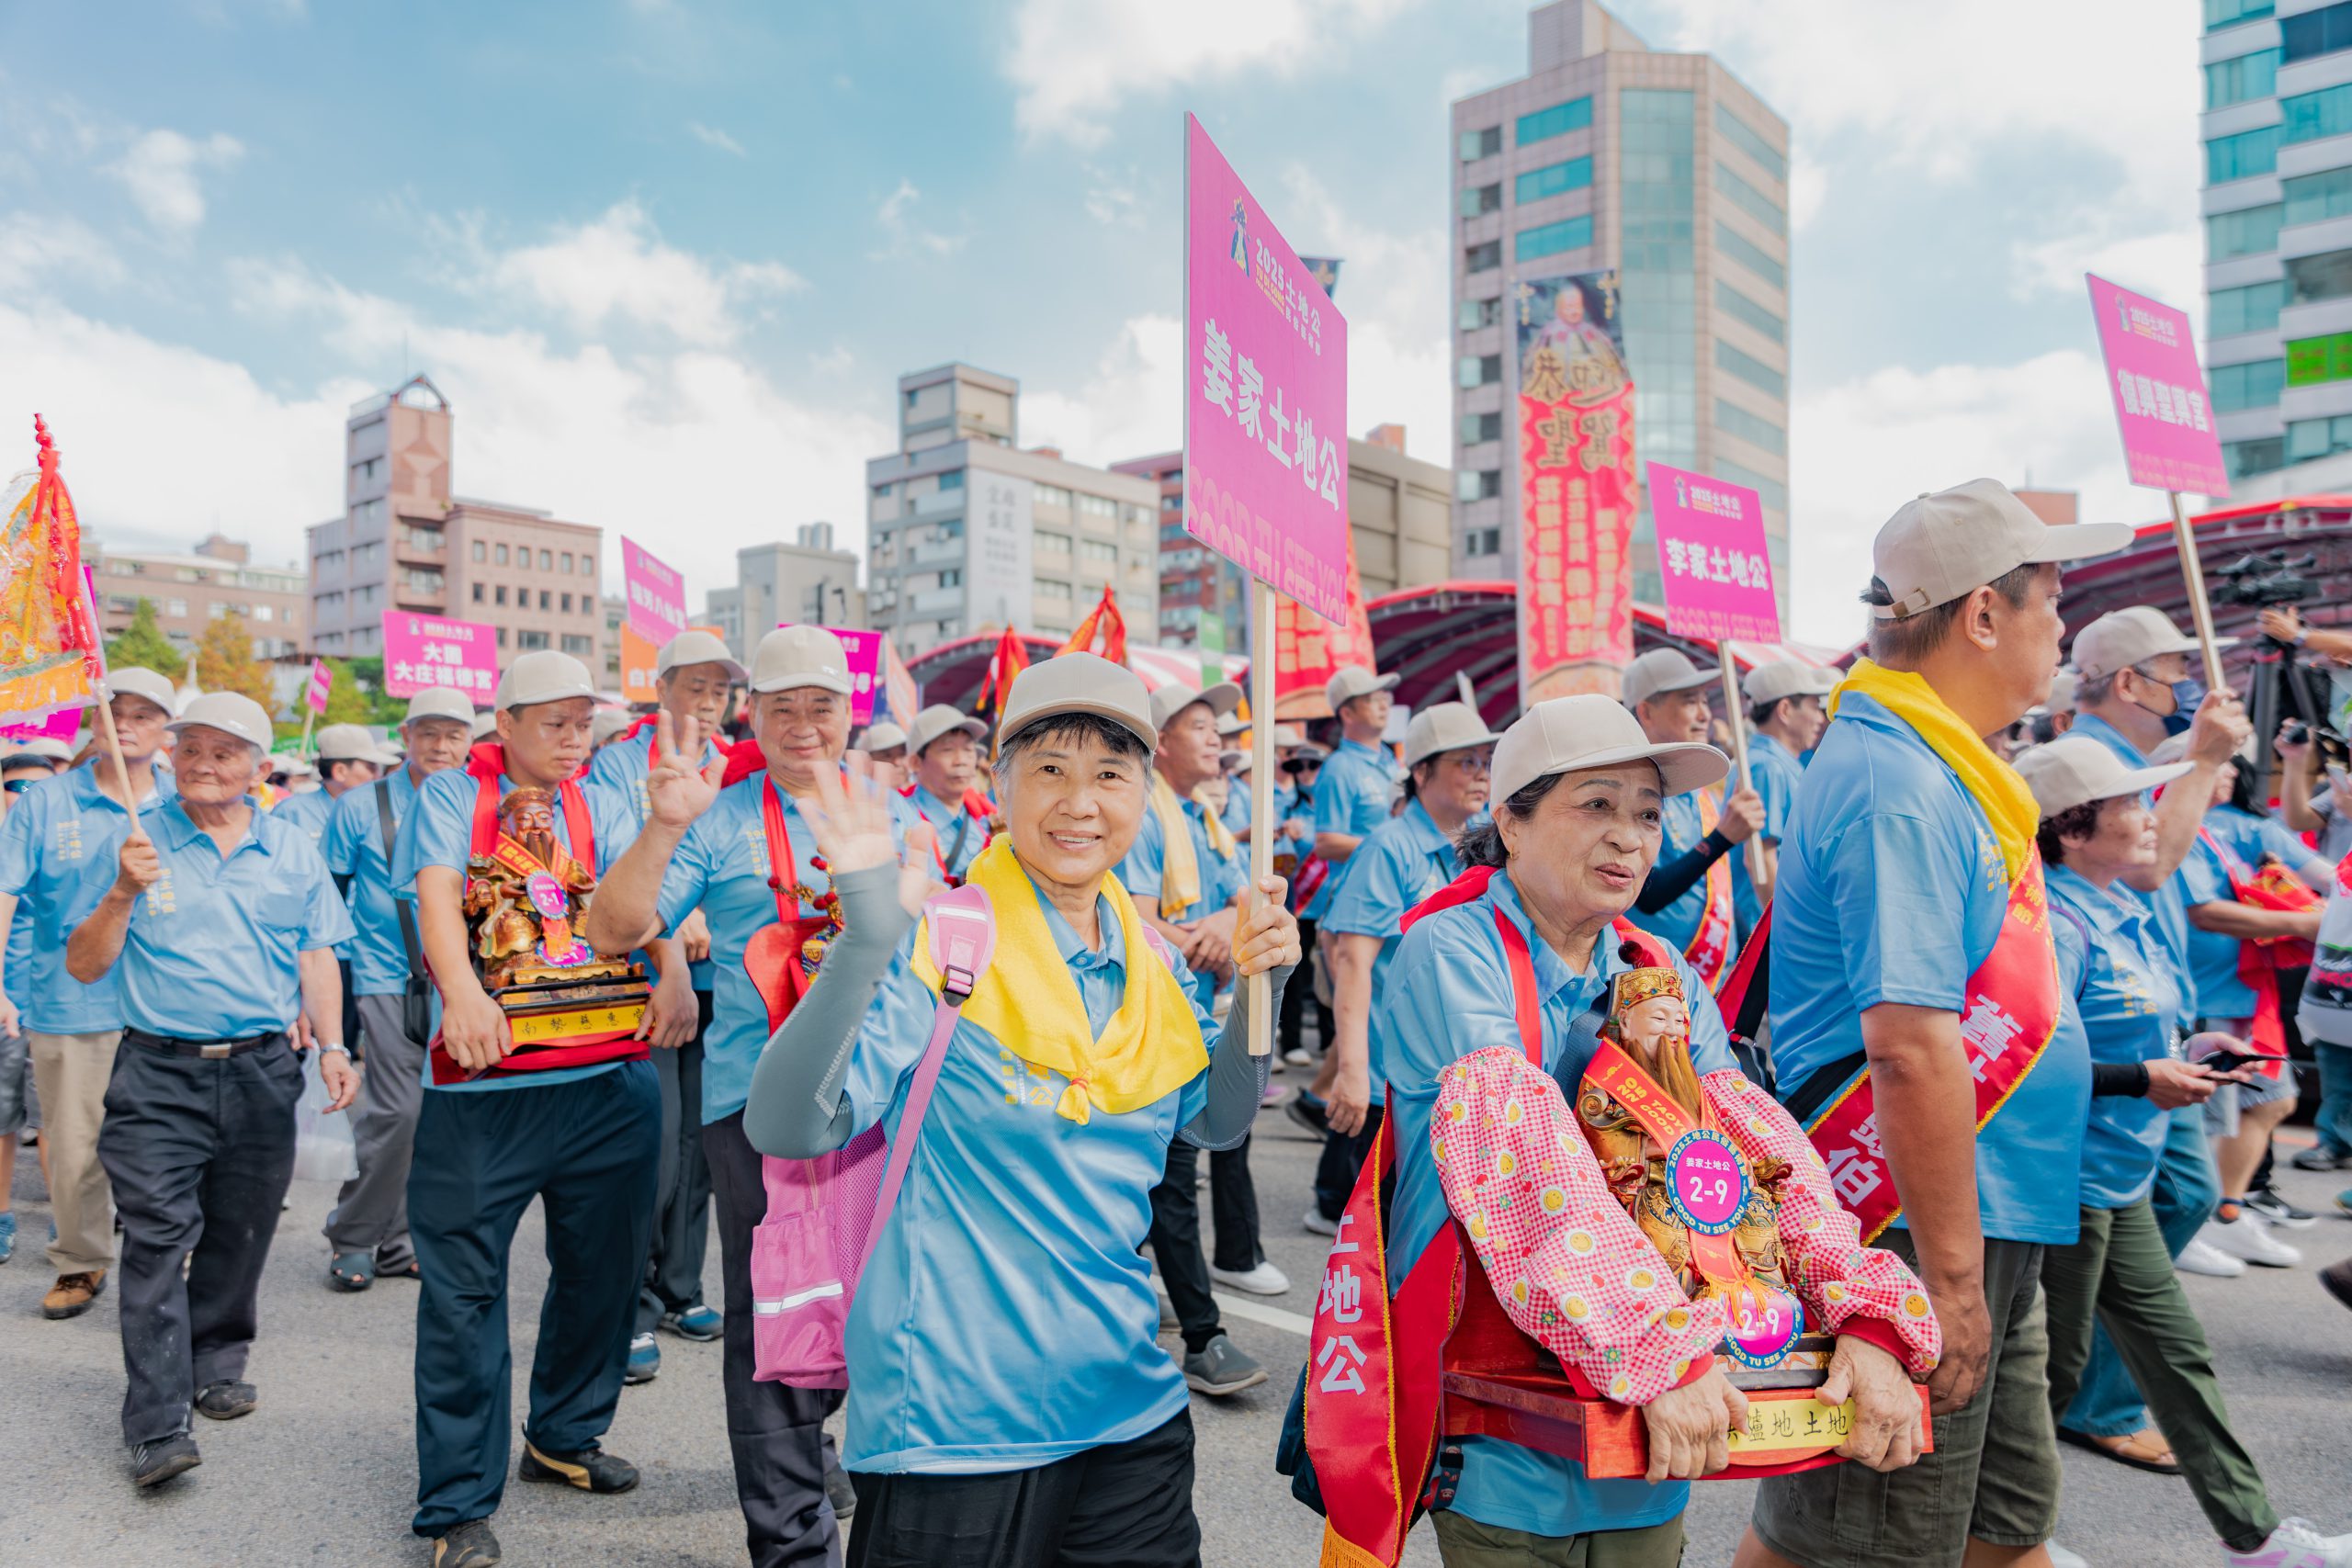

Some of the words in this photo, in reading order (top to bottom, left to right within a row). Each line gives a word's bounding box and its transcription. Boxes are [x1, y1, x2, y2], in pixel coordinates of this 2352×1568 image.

[1204, 319, 1340, 512] 姜家土地公
[1666, 538, 1769, 591] 李家土地公
[539, 892, 560, 907] 2-1
[1640, 1104, 1675, 1136] GOOD
[1686, 1157, 1731, 1171] 姜家土地公
[1690, 1176, 1728, 1205] 2-9
[1673, 1196, 1696, 1226] GOOD
[1698, 1223, 1711, 1234] TU
[1713, 1223, 1730, 1234] SEE
[1729, 1204, 1745, 1224] YOU
[1740, 1307, 1780, 1336] 2-9
[1726, 1333, 1747, 1361] GOOD
[1749, 1357, 1761, 1367] TU
[1764, 1351, 1781, 1366] SEE
[1781, 1332, 1798, 1354] YOU
